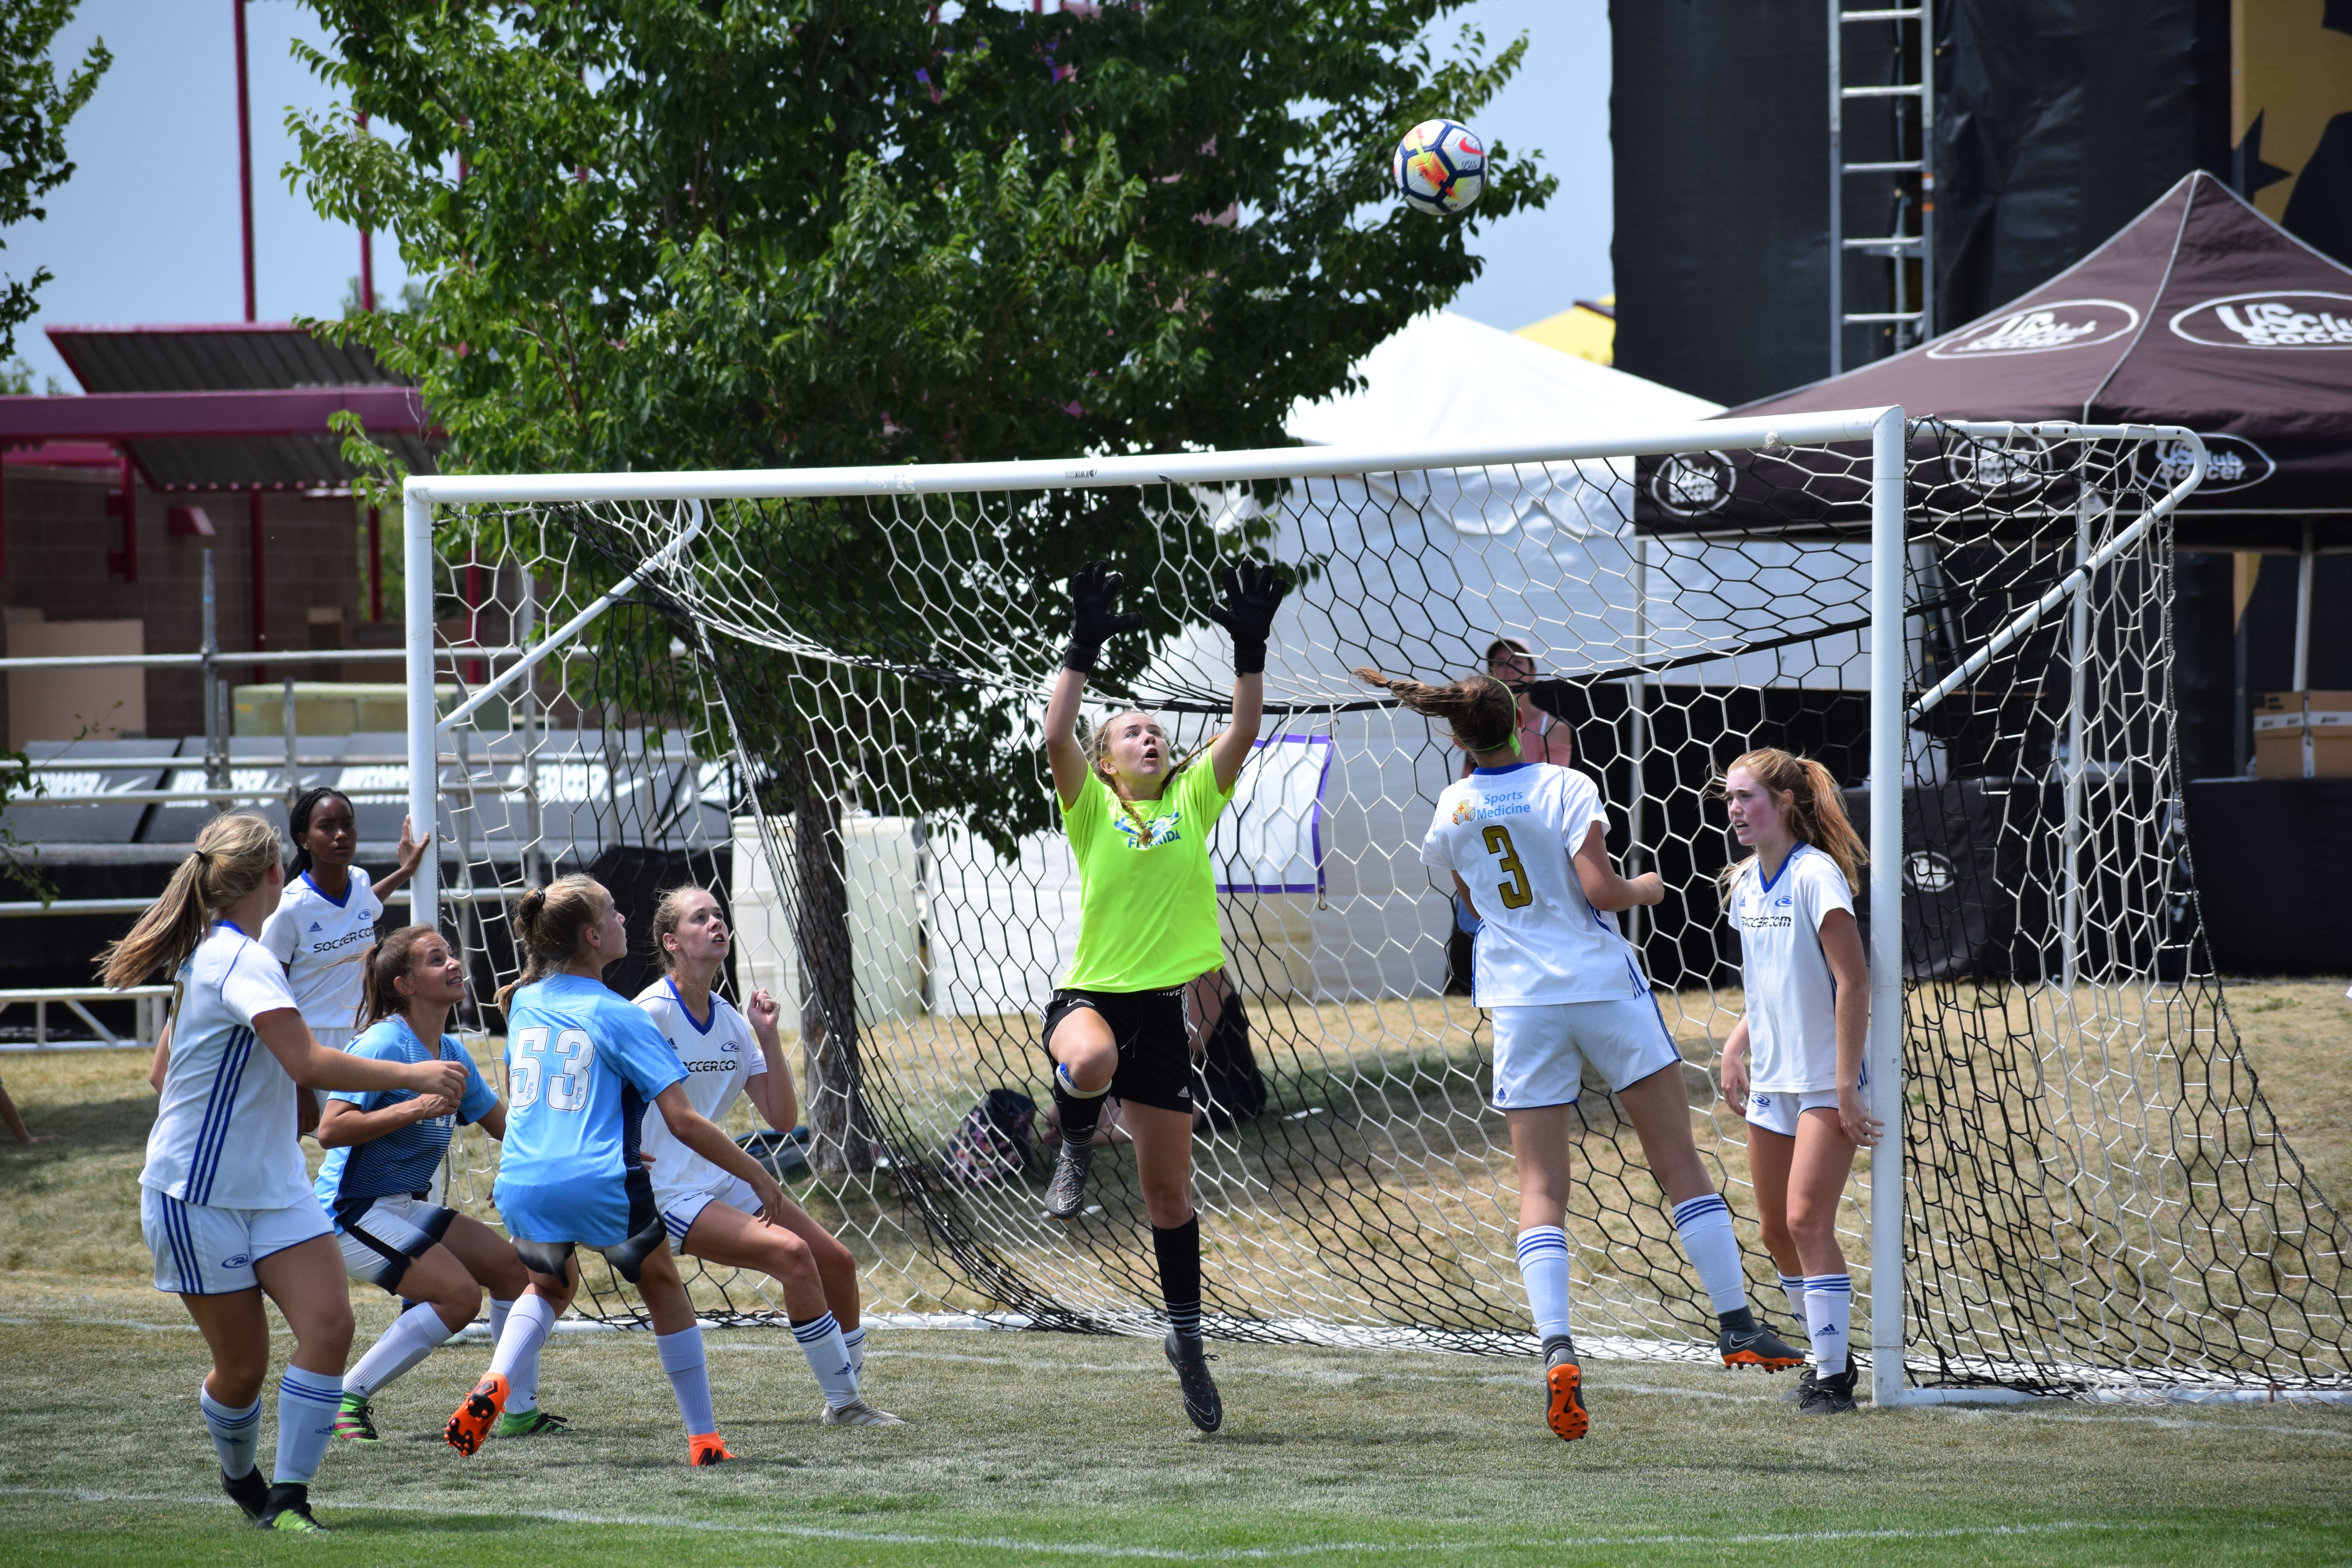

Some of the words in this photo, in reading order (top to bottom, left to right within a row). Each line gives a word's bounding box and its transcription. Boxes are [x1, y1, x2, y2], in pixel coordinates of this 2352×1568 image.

[2215, 303, 2293, 334] US
[2207, 450, 2242, 466] lub
[2159, 465, 2245, 480] Socer
[1484, 791, 1523, 806] Sports
[1477, 804, 1530, 820] Medicine
[1482, 825, 1533, 909] 3
[510, 1026, 595, 1112] 53
[574, 1087, 583, 1106] PDA
